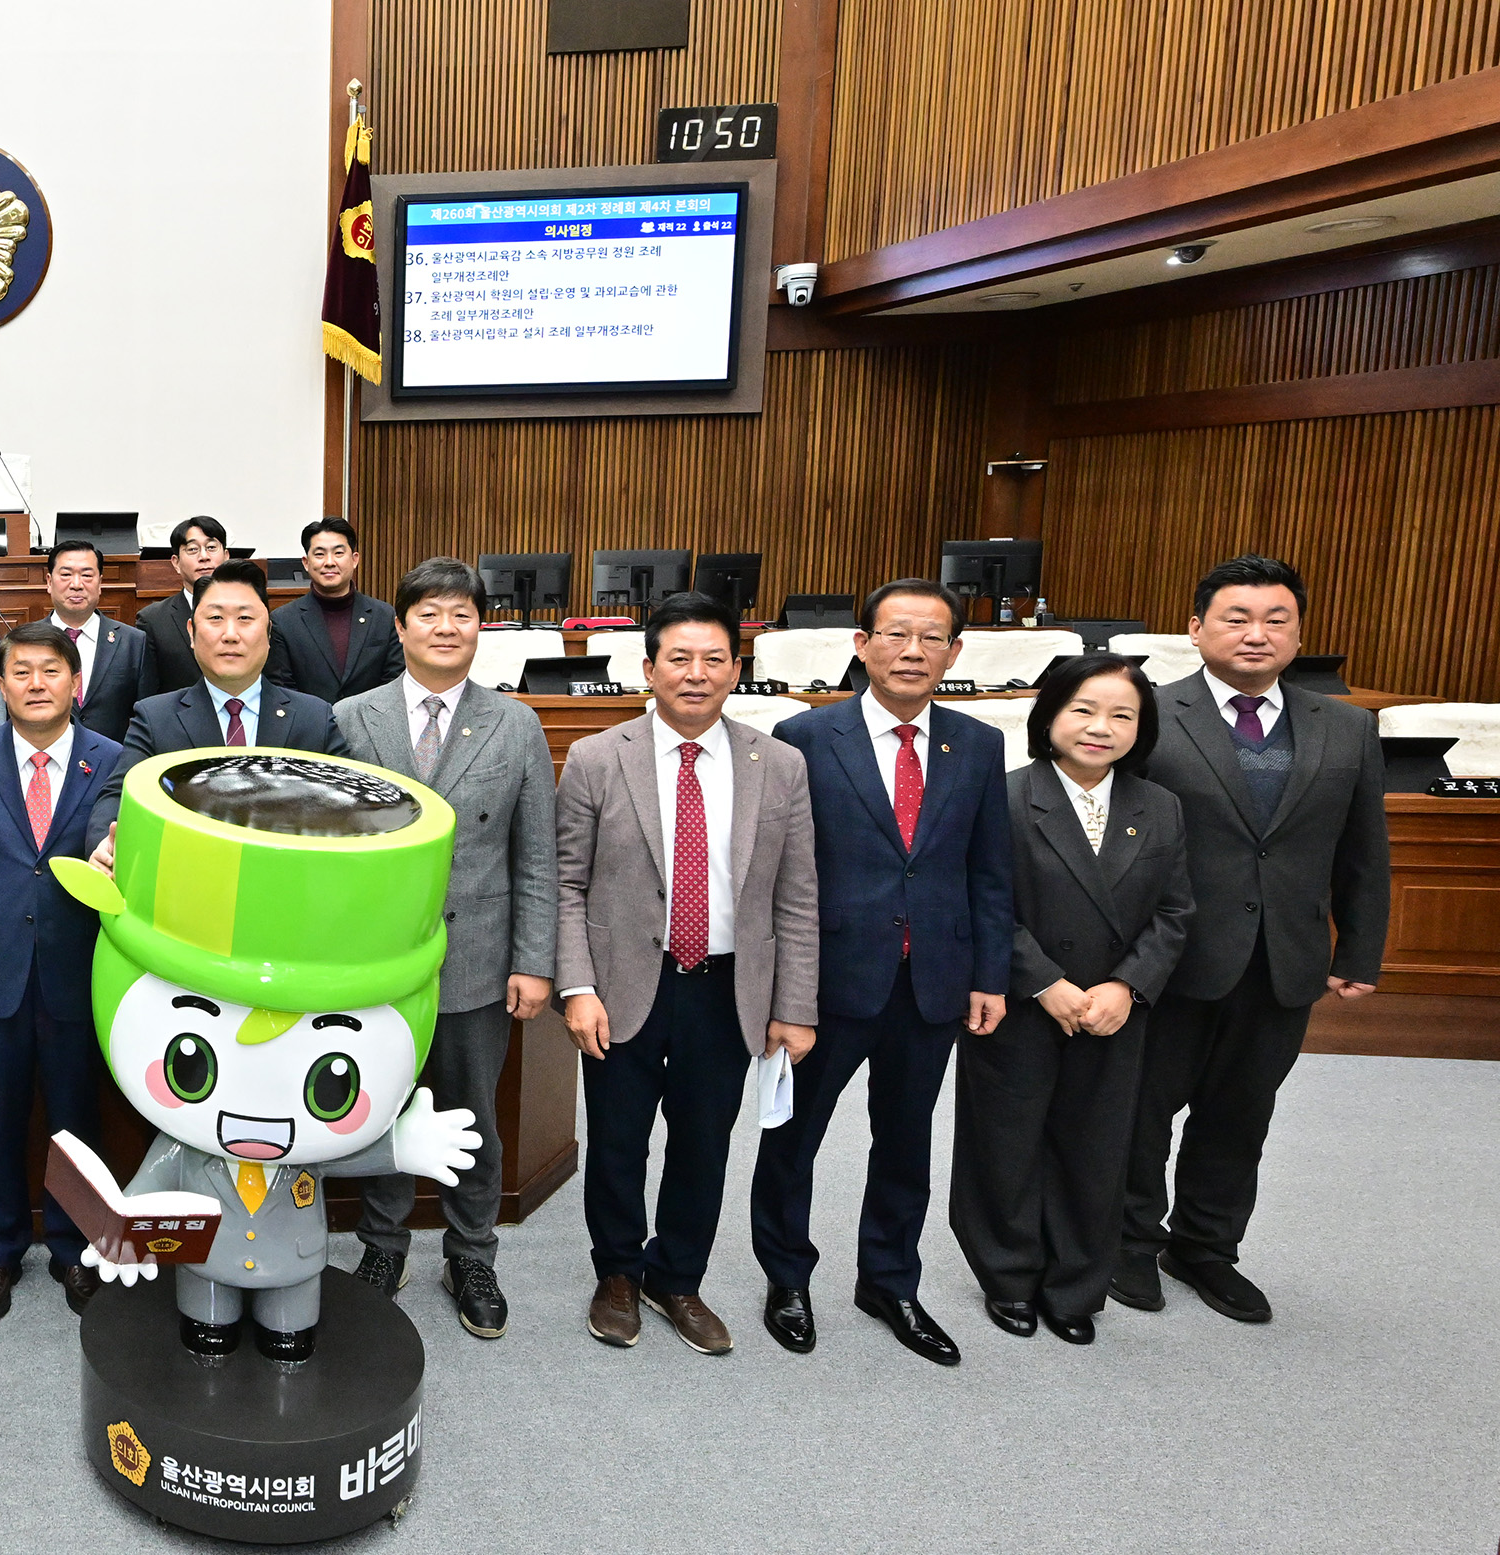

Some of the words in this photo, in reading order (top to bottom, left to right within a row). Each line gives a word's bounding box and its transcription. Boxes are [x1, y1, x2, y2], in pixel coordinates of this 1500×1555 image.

[430, 206, 476, 220] 제260회
[480, 203, 561, 219] 울산광역시의회
[565, 203, 597, 216] 제2차
[600, 201, 636, 215] 정례회
[639, 200, 671, 213] 제4차
[674, 198, 711, 212] 본회의
[544, 224, 592, 238] 의사일정
[675, 223, 687, 231] 22
[721, 221, 732, 230] 22
[406, 252, 428, 266] 36.
[432, 250, 521, 264] 울산광역시교육감
[525, 249, 547, 260] 소속
[552, 247, 608, 260] 지방공무원
[613, 246, 634, 258] 정원
[638, 245, 661, 257] 조례
[431, 270, 509, 283] 일부개정조례안
[405, 291, 427, 304] 37.
[431, 290, 486, 303] 울산광역시
[490, 288, 523, 301] 학원의
[580, 286, 590, 298] 및
[594, 285, 652, 298] 과외교습에
[655, 284, 678, 296] 관한
[430, 310, 452, 321] 조례
[456, 308, 534, 321] 일부개정조례안
[404, 329, 426, 343] 38.
[430, 327, 519, 341] 울산광역시립학교
[523, 327, 544, 339] 설치
[548, 326, 571, 337] 조례
[575, 324, 654, 337] 일부개정조례안
[116, 1440, 138, 1466] 의회
[339, 1403, 422, 1501] 바르미
[160, 1455, 315, 1501] 울산광역시의회
[160, 1479, 191, 1500] ULSAN
[192, 1490, 270, 1513] METROPOLITAN
[272, 1502, 316, 1514] COUNCIL
